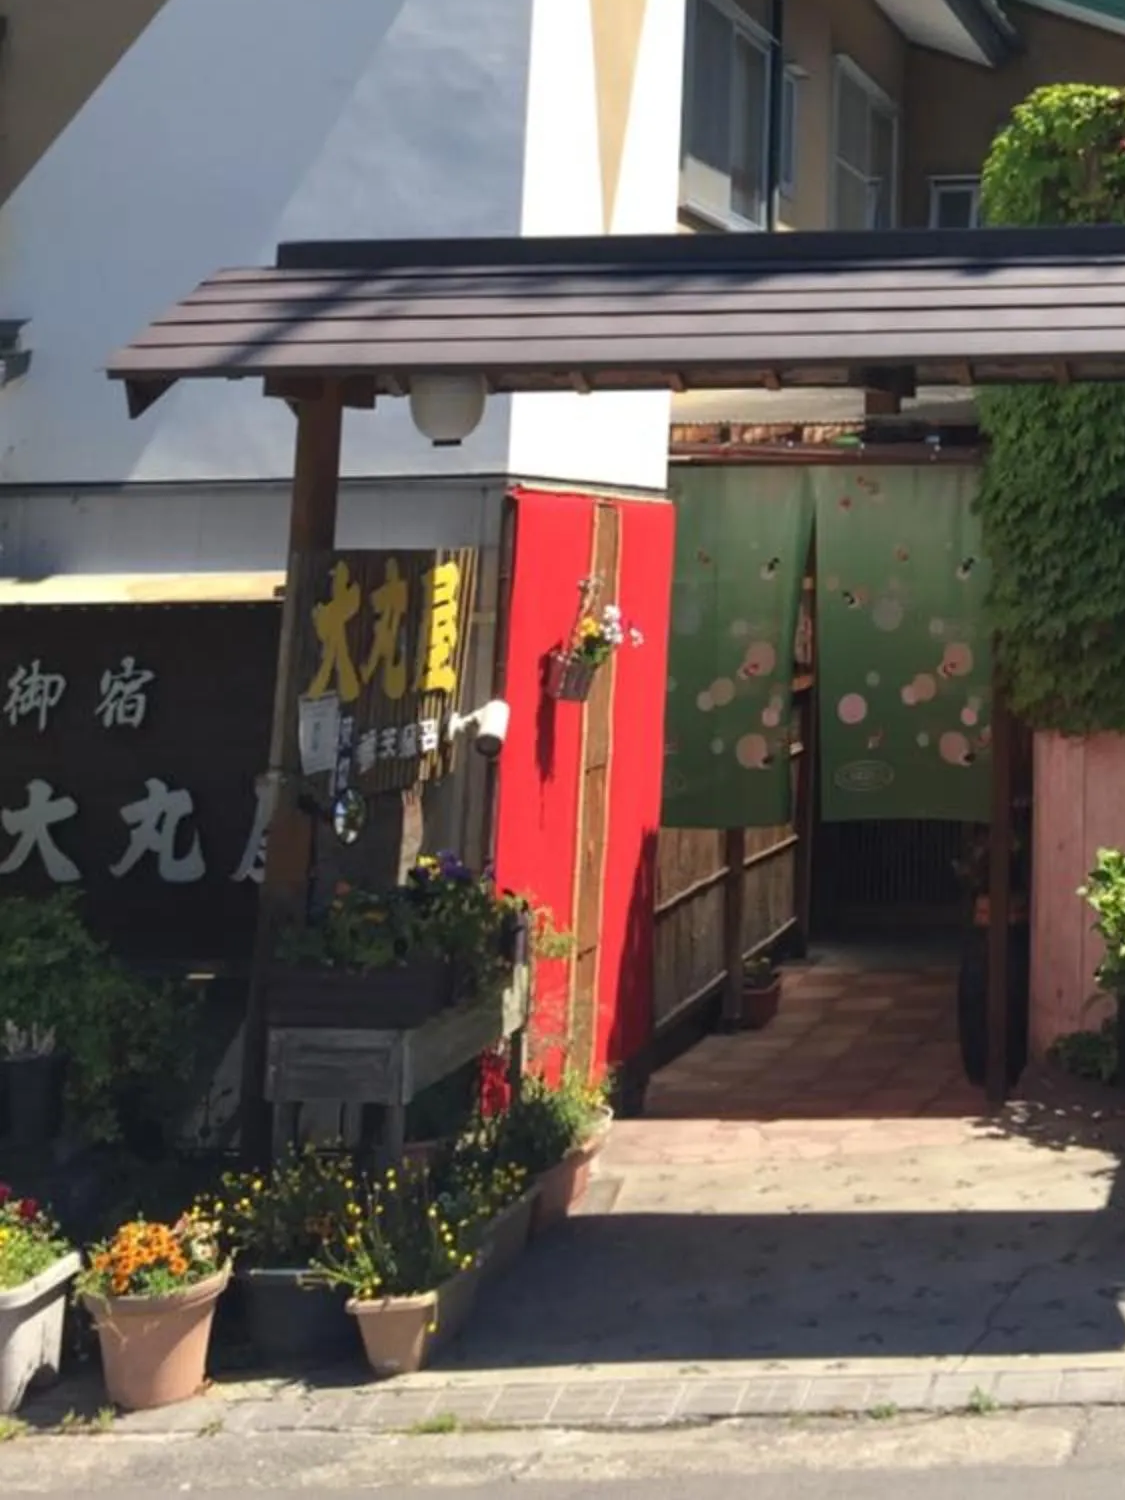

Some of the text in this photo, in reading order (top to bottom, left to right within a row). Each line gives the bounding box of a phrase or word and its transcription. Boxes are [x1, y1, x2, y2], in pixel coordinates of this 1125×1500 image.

[307, 559, 460, 702] 大丸屋
[2, 655, 156, 733] 御宿
